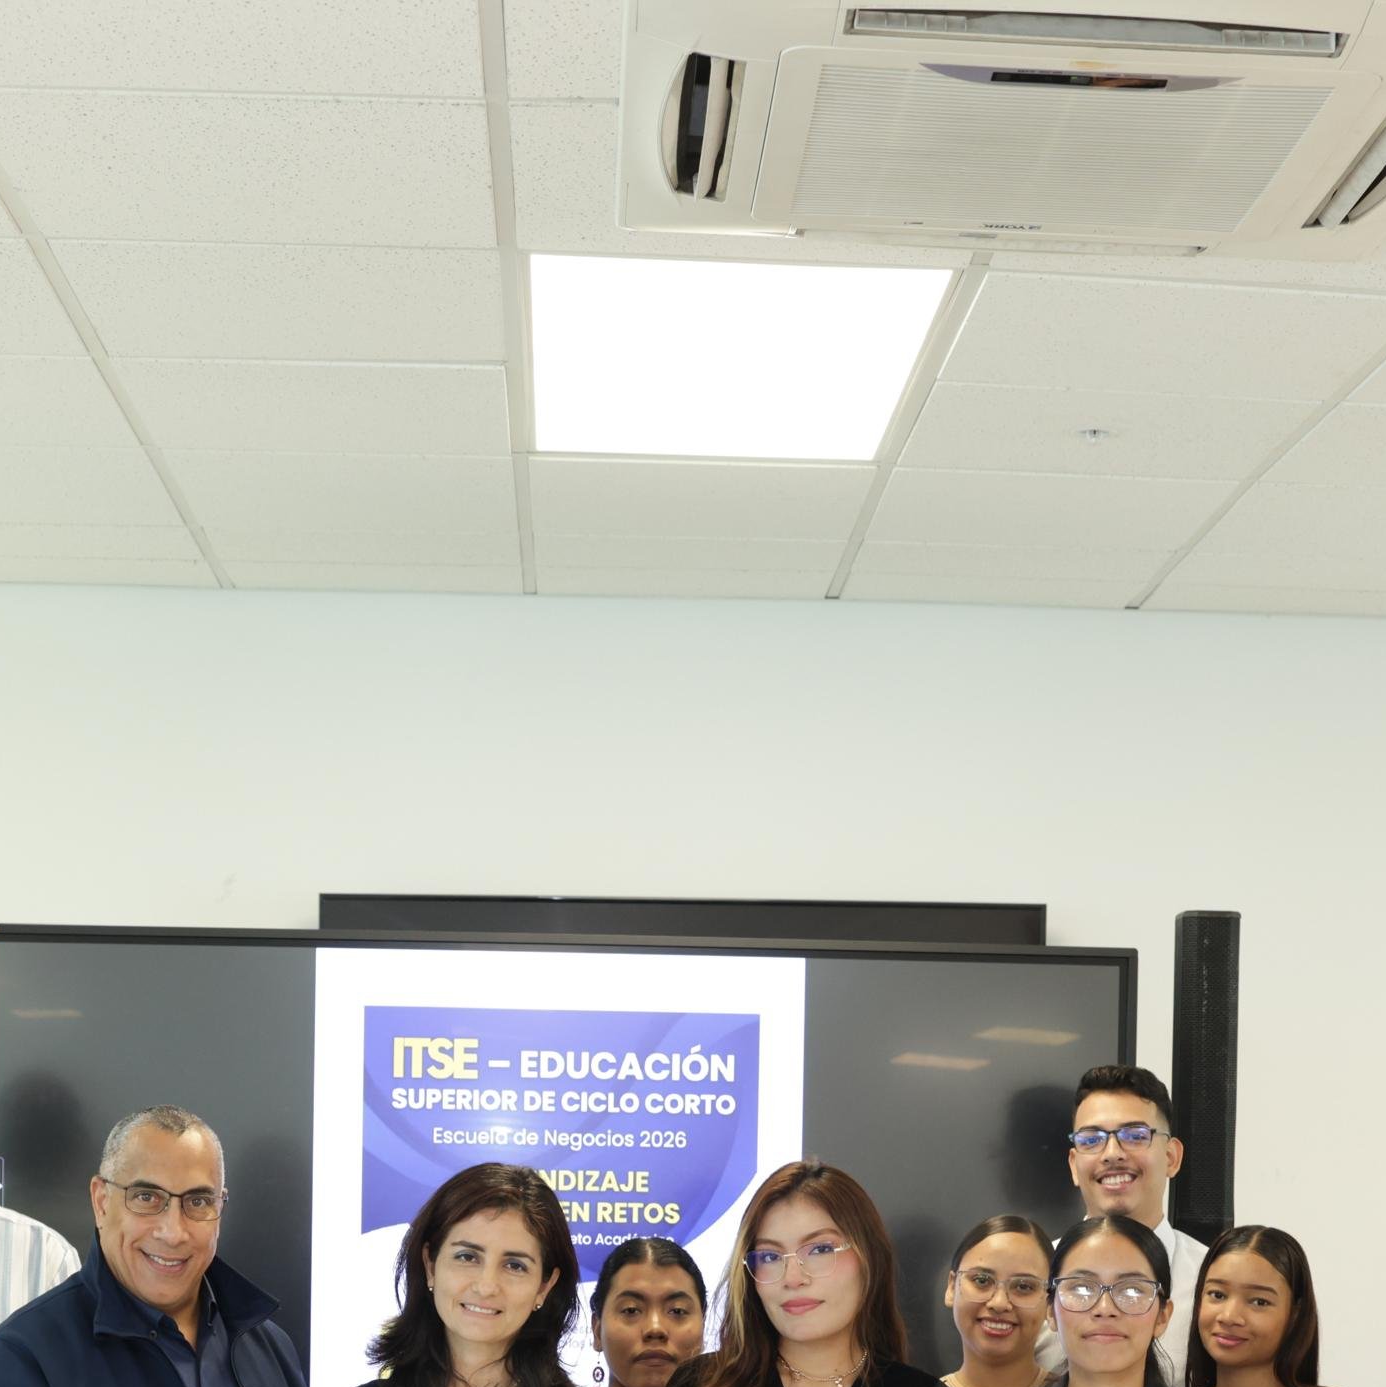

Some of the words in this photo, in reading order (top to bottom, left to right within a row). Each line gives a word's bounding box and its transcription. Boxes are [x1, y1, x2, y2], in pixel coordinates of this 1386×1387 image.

[392, 1037, 479, 1080] ITSE
[520, 1045, 736, 1082] EDUCACIÓN
[391, 1087, 518, 1112] SUPERIOR
[524, 1090, 556, 1112] DE
[561, 1091, 640, 1114] CICLO
[645, 1093, 737, 1116] CORTO
[432, 1127, 510, 1146] Escuela
[513, 1128, 539, 1146] de
[544, 1129, 635, 1152] Negocios
[639, 1131, 688, 1149] 2026
[535, 1169, 650, 1193] NDIZAJE
[597, 1202, 681, 1225] RETOS
[571, 1233, 592, 1246] eto
